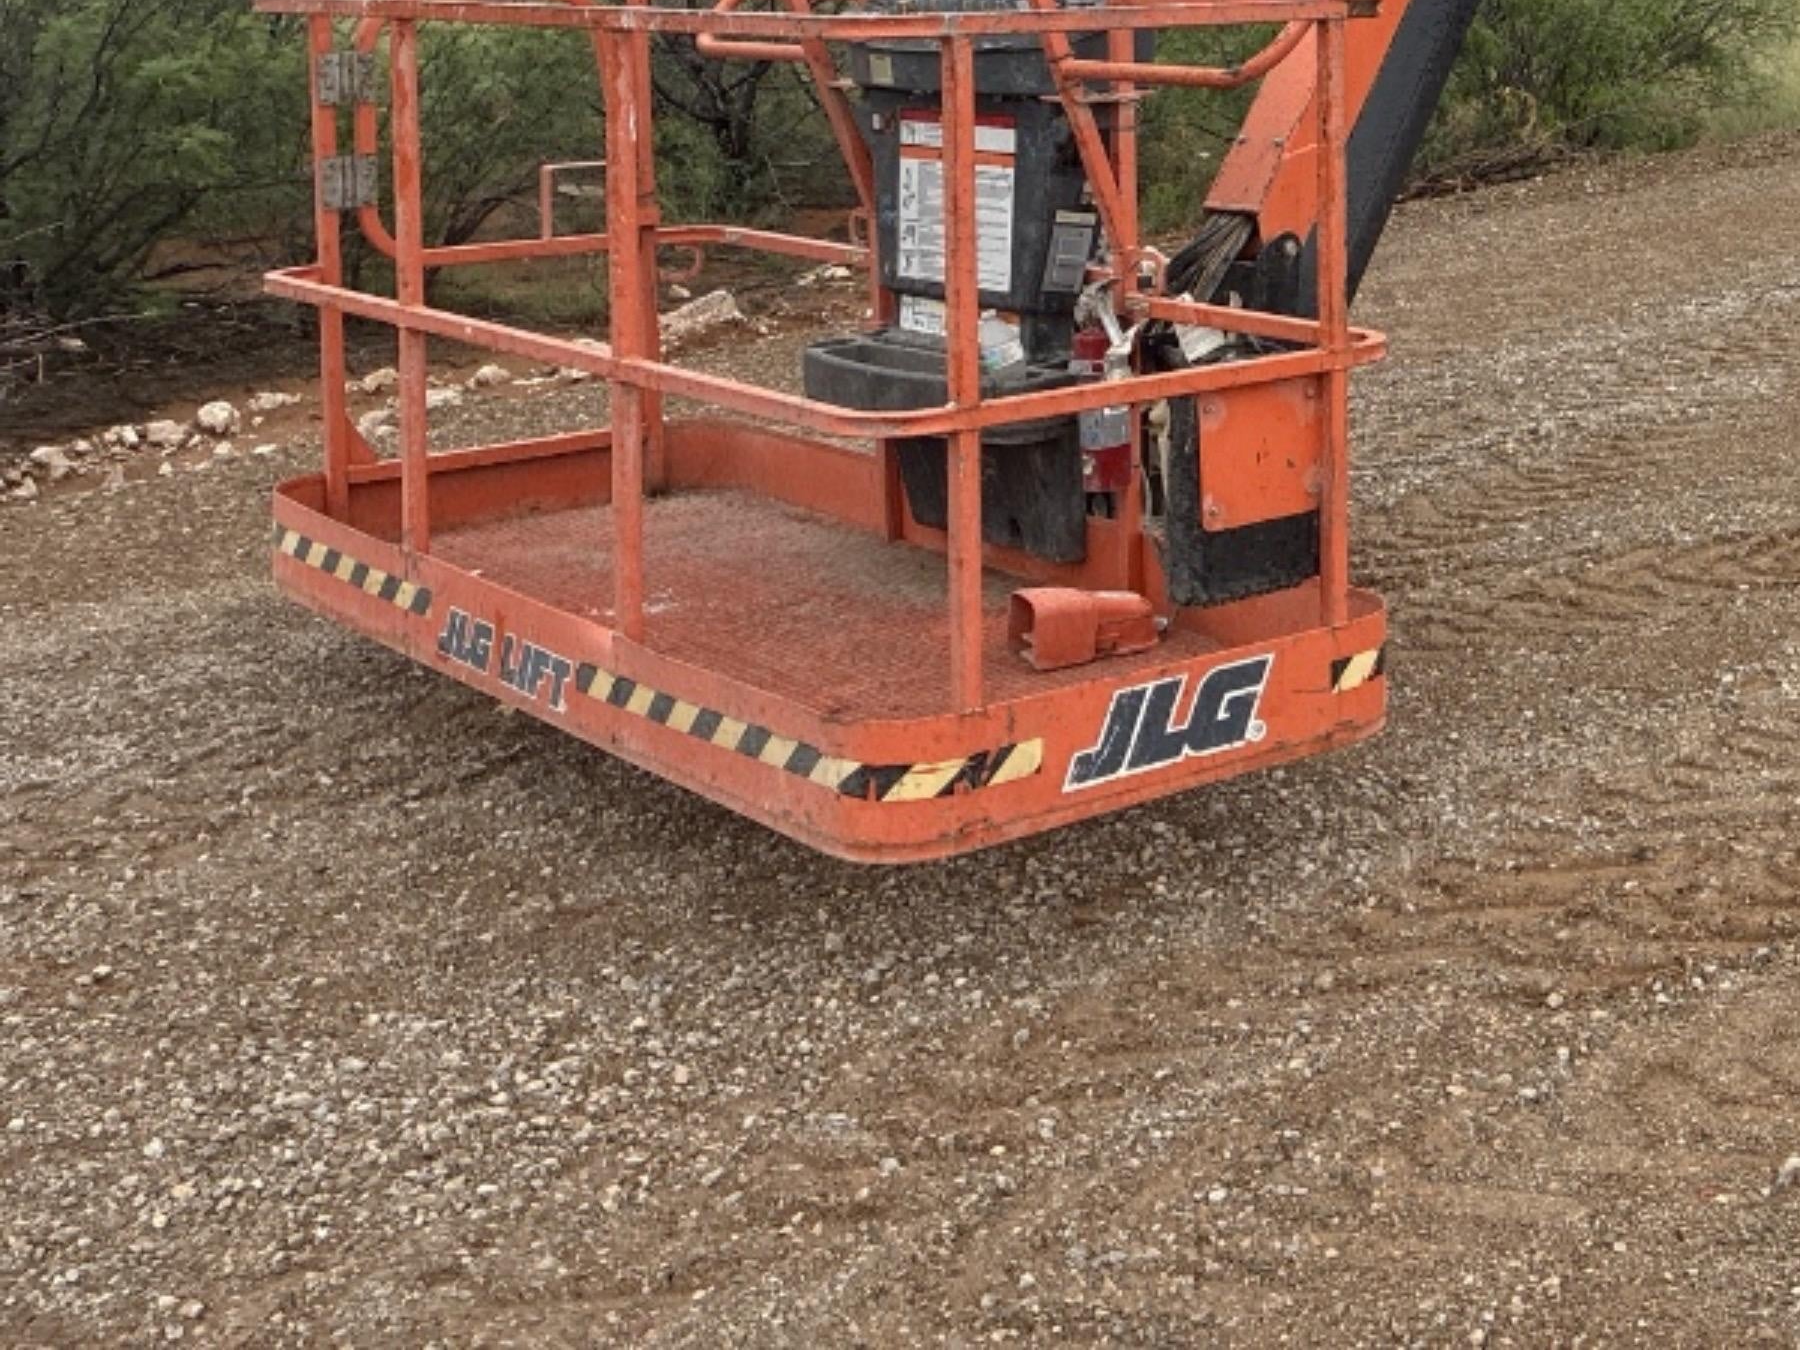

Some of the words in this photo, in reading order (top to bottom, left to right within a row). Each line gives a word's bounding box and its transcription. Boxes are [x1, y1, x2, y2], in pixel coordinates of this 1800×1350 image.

[438, 606, 495, 674] JLG
[499, 632, 573, 713] LIFT
[1062, 653, 1275, 793] JLG
